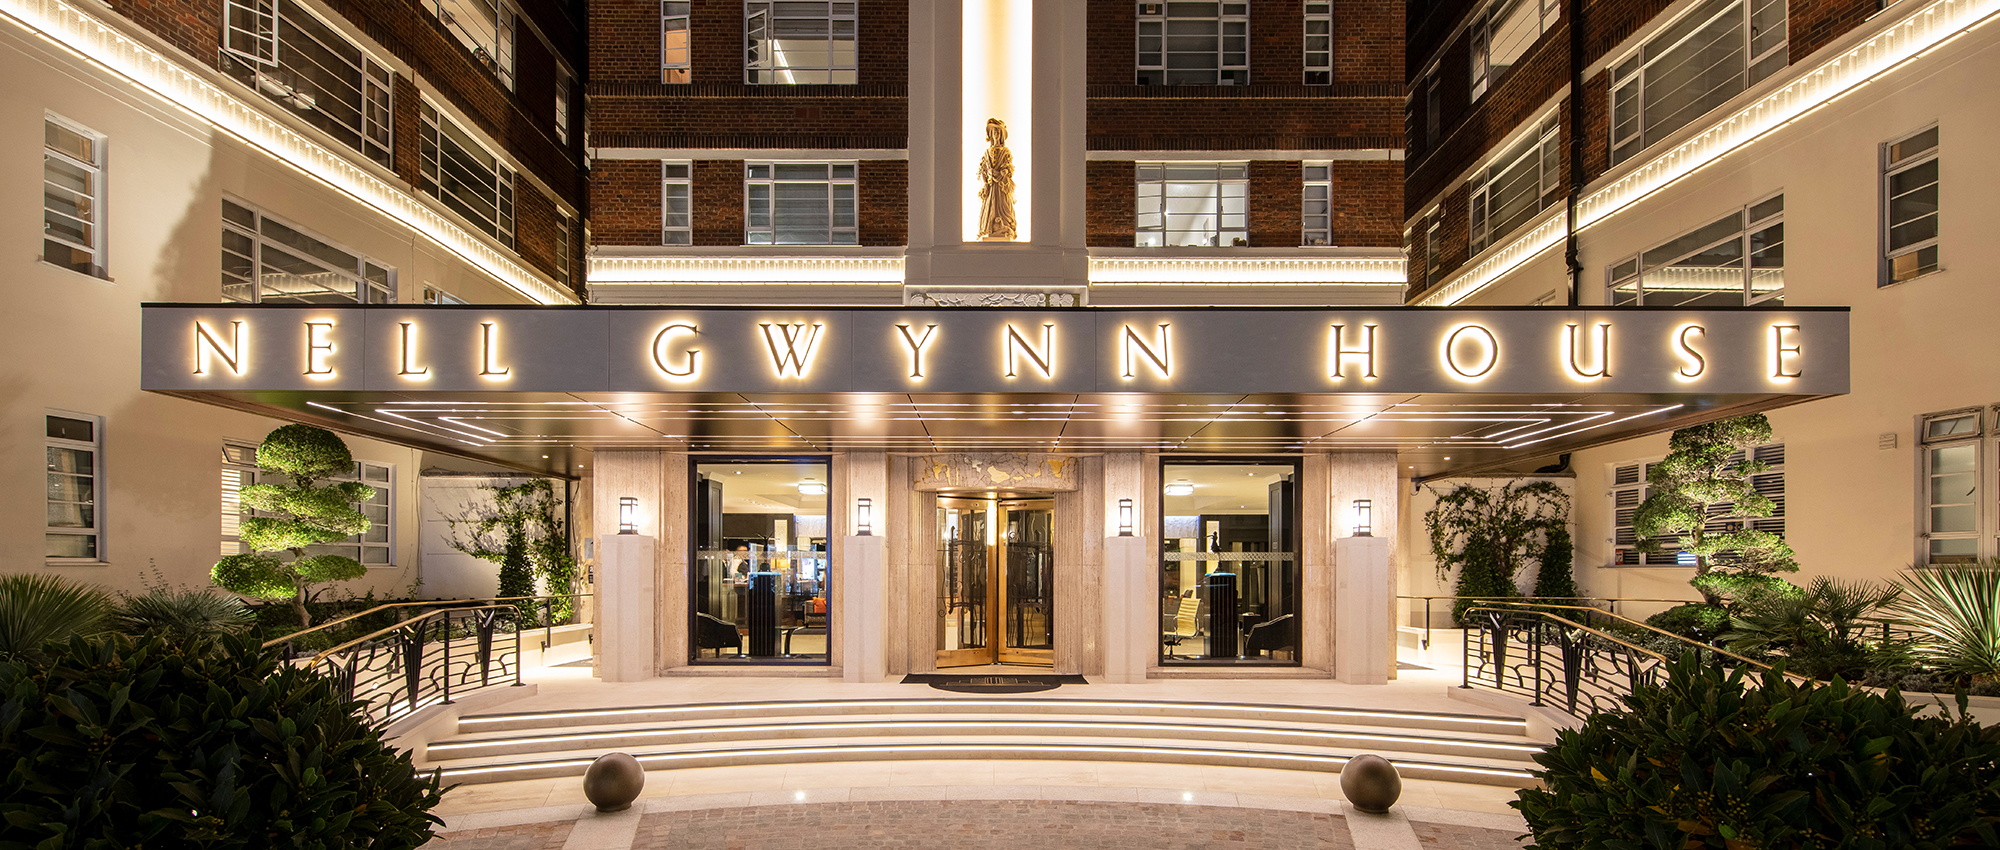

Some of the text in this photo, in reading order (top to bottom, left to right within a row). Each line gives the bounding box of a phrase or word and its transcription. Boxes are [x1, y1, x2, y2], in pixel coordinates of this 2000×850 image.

[192, 320, 1803, 378] NELL GWYNN HOUSE
